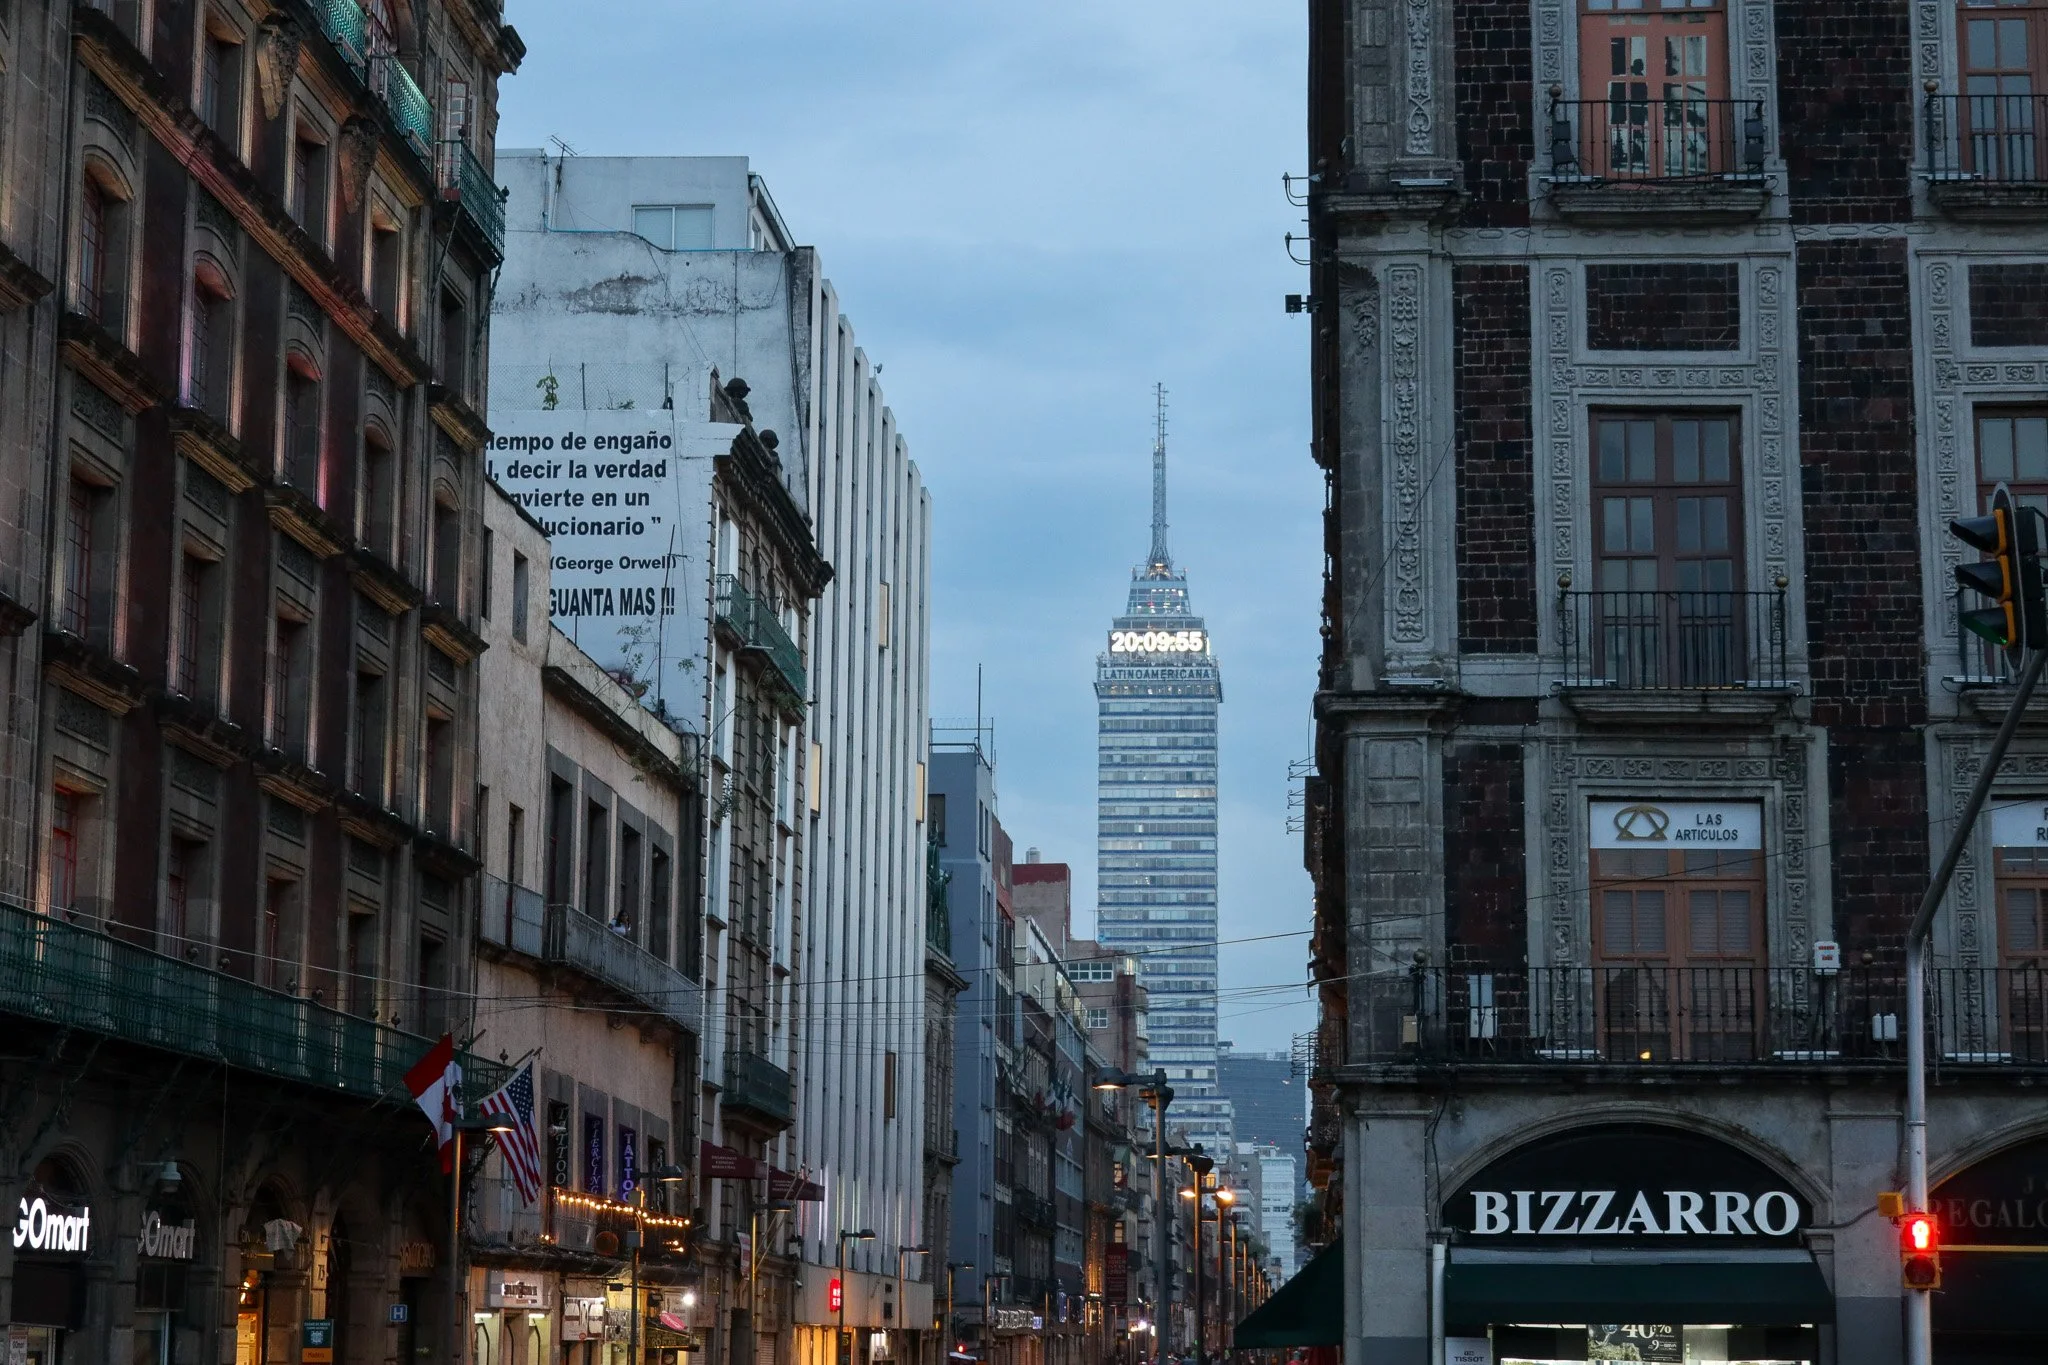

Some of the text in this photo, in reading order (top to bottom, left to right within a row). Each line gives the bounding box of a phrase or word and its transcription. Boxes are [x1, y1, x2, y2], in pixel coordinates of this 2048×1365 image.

[561, 432, 587, 451] de
[593, 432, 672, 455] engaño
[507, 460, 562, 479] decir
[569, 460, 587, 479] la
[594, 459, 667, 479] verdad
[591, 493, 617, 507] en
[625, 493, 650, 507] un
[620, 587, 656, 616] MAS
[1111, 631, 1203, 652] 20:09:55
[1103, 670, 1210, 680] LATINOAMERICANA
[1696, 813, 1722, 826] LAS
[1675, 829, 1738, 841] ARTICULOS
[1470, 1190, 1800, 1236] BIZZARRO
